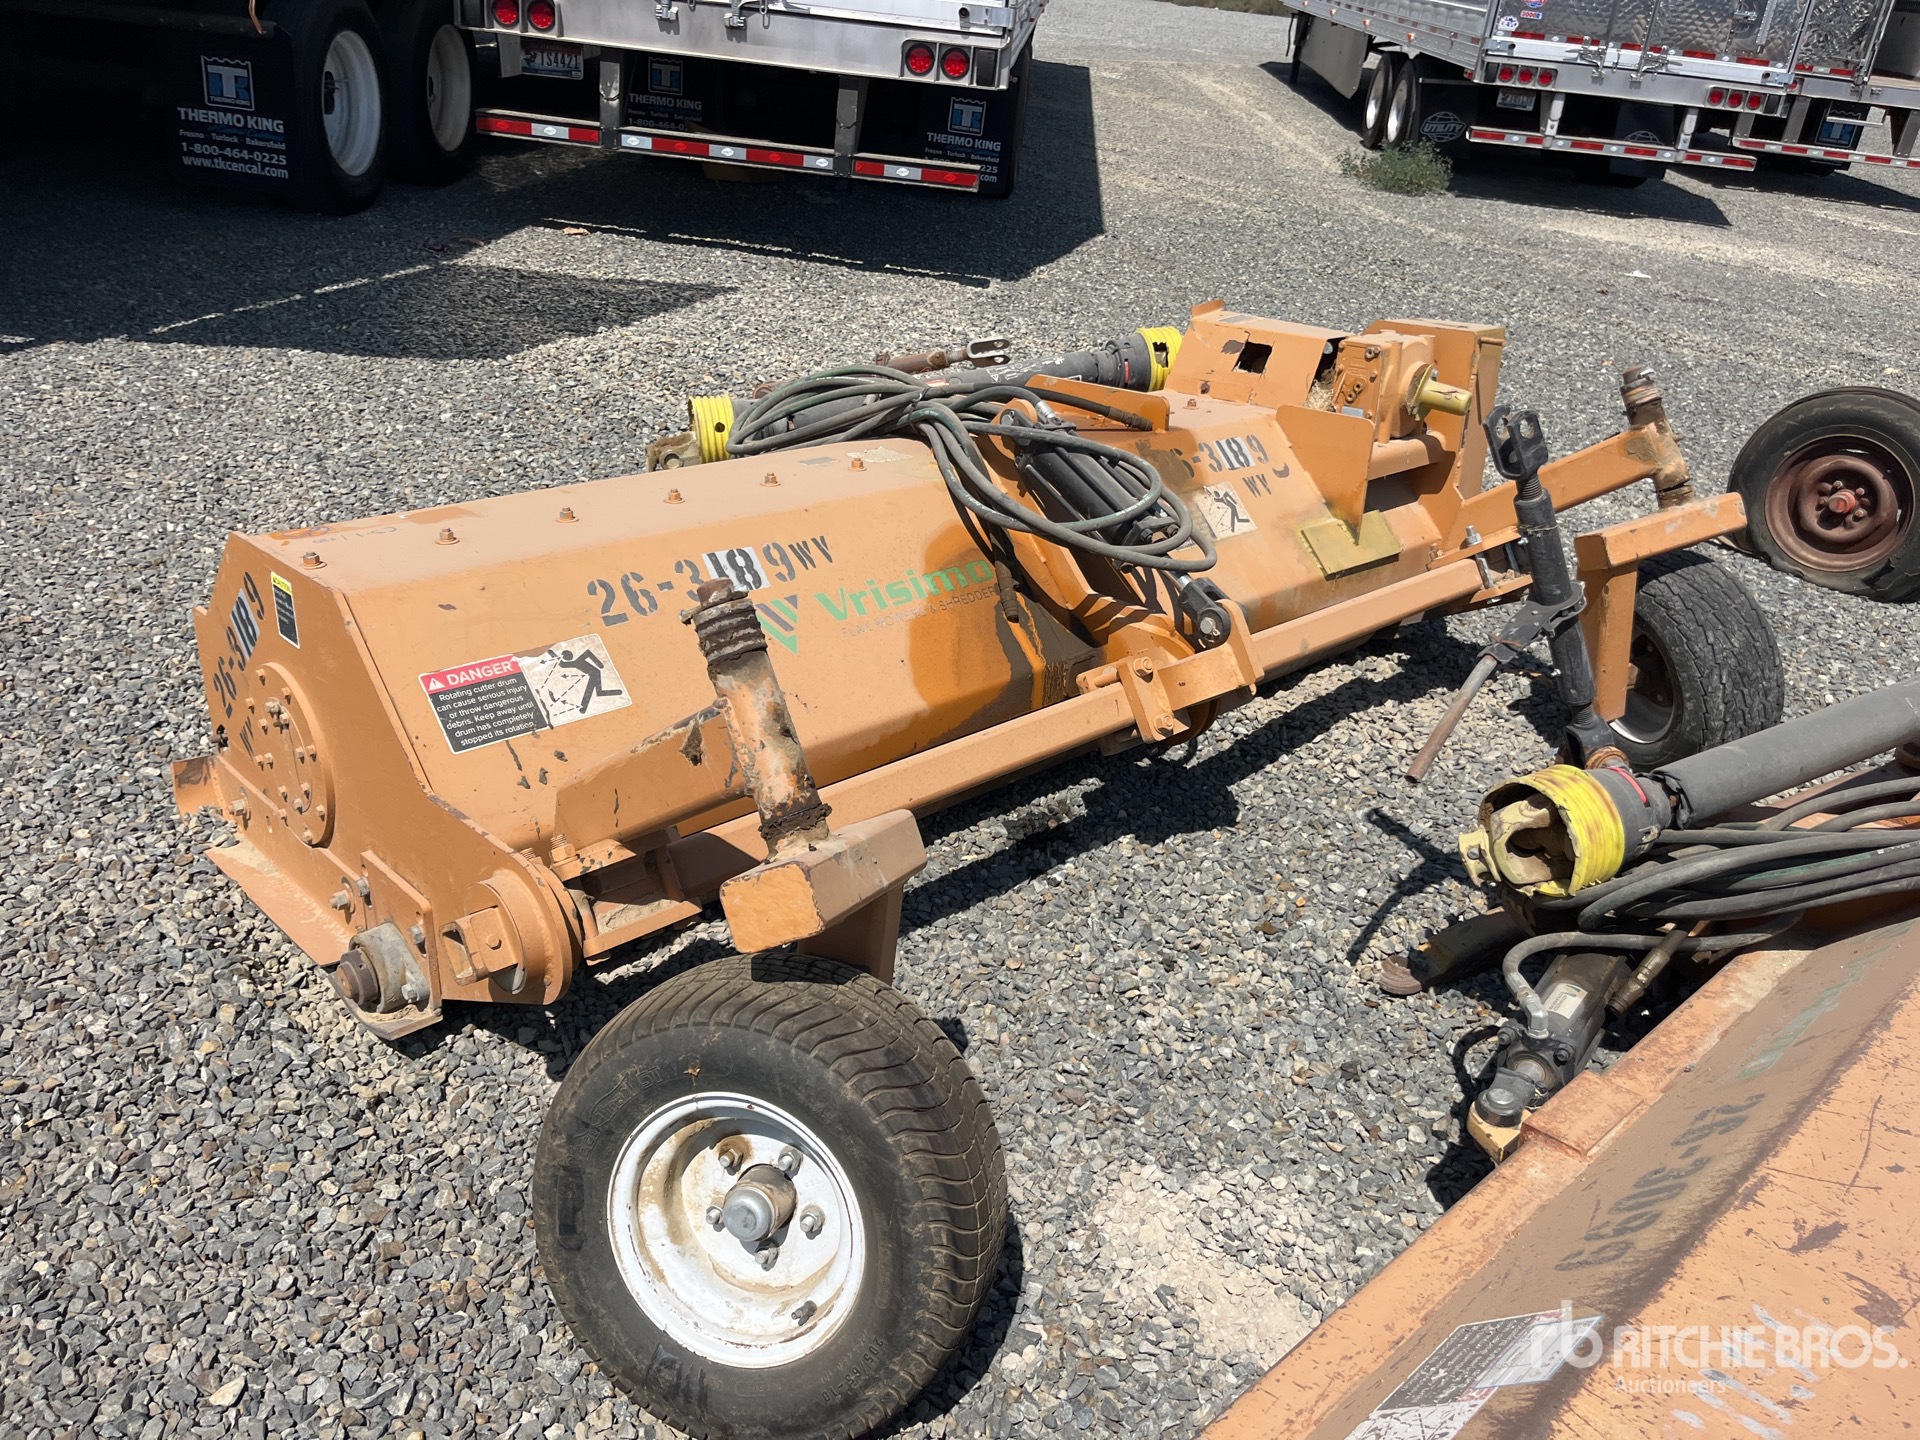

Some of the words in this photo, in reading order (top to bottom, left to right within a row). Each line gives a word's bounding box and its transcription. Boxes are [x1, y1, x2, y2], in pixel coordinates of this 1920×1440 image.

[628, 92, 675, 109] THERMO
[676, 98, 703, 112] KING
[177, 106, 245, 129] THERMO
[246, 115, 285, 134] KING
[1422, 122, 1464, 134] UTILITY
[179, 128, 205, 139] Fresno
[211, 132, 240, 144] Turlock
[245, 137, 287, 151] Bakersfield
[926, 130, 973, 148] THERMO
[974, 138, 1002, 152] KING
[180, 142, 287, 165] 1-800-464-0225
[182, 155, 289, 179] www.tkcencal.com
[812, 559, 995, 621] Vrisimo
[445, 661, 514, 687] DANGER
[436, 703, 452, 713] can
[453, 697, 477, 710] cause
[477, 690, 506, 703] serious
[506, 684, 528, 698] injury
[438, 687, 473, 703] Rotating
[473, 682, 496, 695] cutter
[497, 677, 518, 689] drum
[446, 718, 474, 731] debris.
[474, 711, 496, 724] Keep
[496, 704, 518, 718] away
[517, 700, 535, 713] until
[449, 712, 459, 720] or
[459, 705, 482, 718] throw
[482, 693, 525, 712] dangerous
[454, 726, 477, 739] drum
[477, 721, 492, 732] has
[492, 711, 536, 729] completely
[460, 731, 495, 748] stopped
[494, 728, 505, 737] its
[1553, 1092, 1767, 1272] 26-3099
